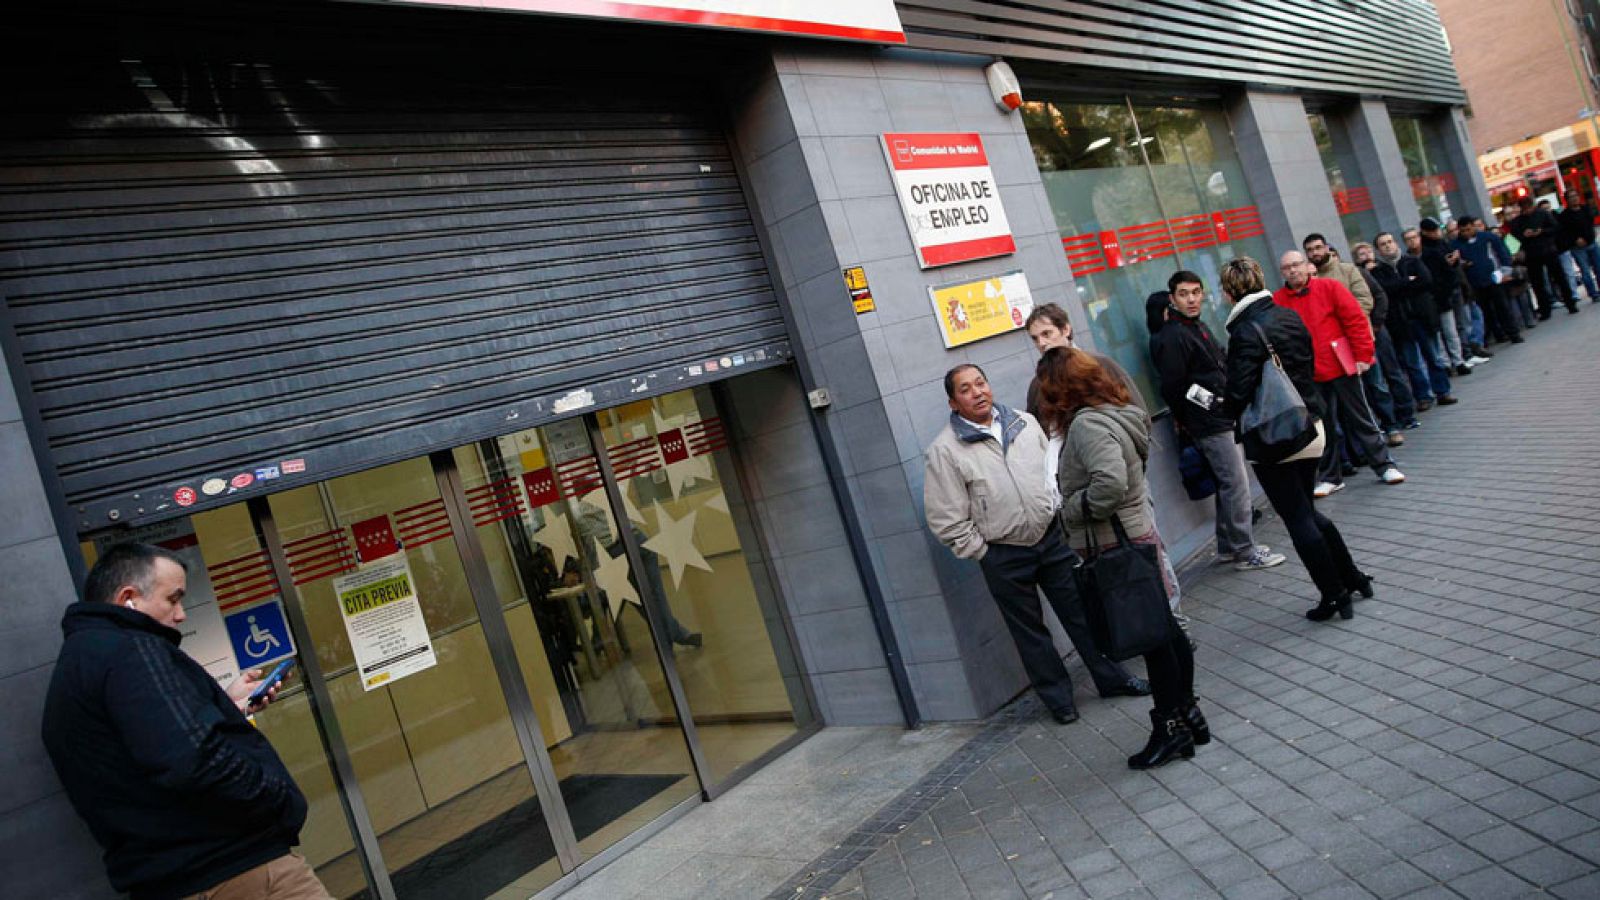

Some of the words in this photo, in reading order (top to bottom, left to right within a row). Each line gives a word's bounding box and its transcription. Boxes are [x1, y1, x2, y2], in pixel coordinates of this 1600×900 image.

[910, 145, 948, 156] Comunidad
[956, 144, 979, 155] Madrid
[911, 182, 972, 204] OFICINA
[971, 180, 992, 199] DE
[929, 205, 989, 229] EMPLEO
[344, 592, 372, 614] CITA
[371, 579, 410, 605] PREVIA
